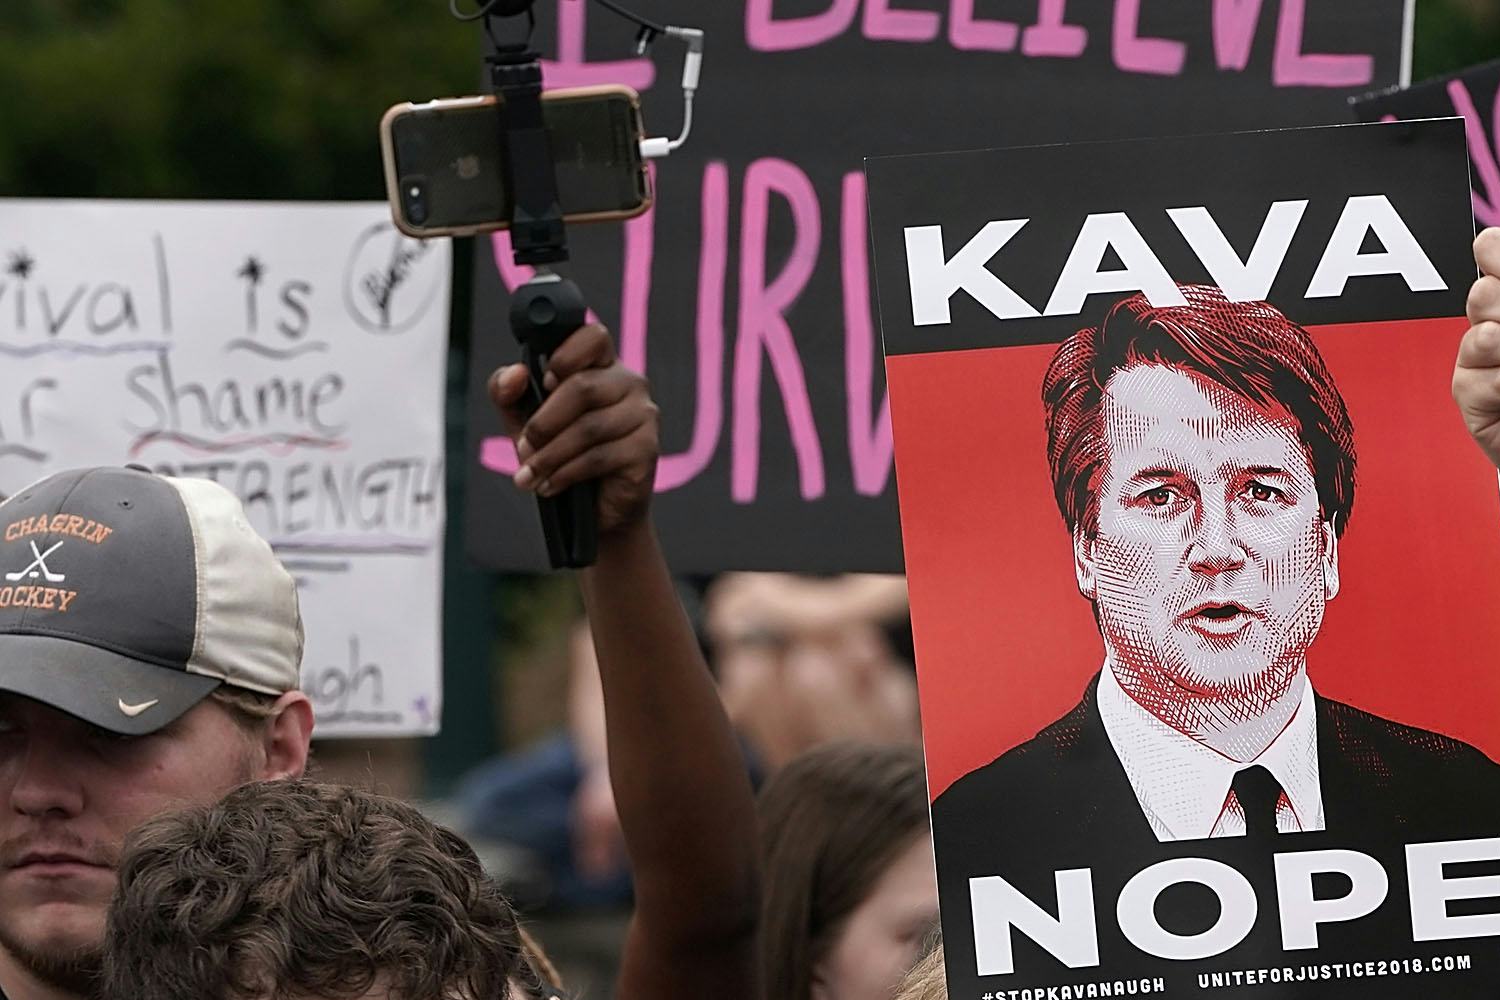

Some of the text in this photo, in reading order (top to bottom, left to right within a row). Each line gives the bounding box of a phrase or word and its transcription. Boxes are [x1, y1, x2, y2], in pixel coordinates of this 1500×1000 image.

[0, 230, 173, 338] ival
[236, 254, 314, 341] is
[903, 195, 1448, 327] KAVA
[0, 346, 346, 438] r Shame
[5, 513, 113, 544] CHAGRIN
[155, 456, 443, 534] RENGTH
[0, 586, 77, 612] OCKEY
[1198, 954, 1472, 989] UNITEFORJUSTICE2018.COM
